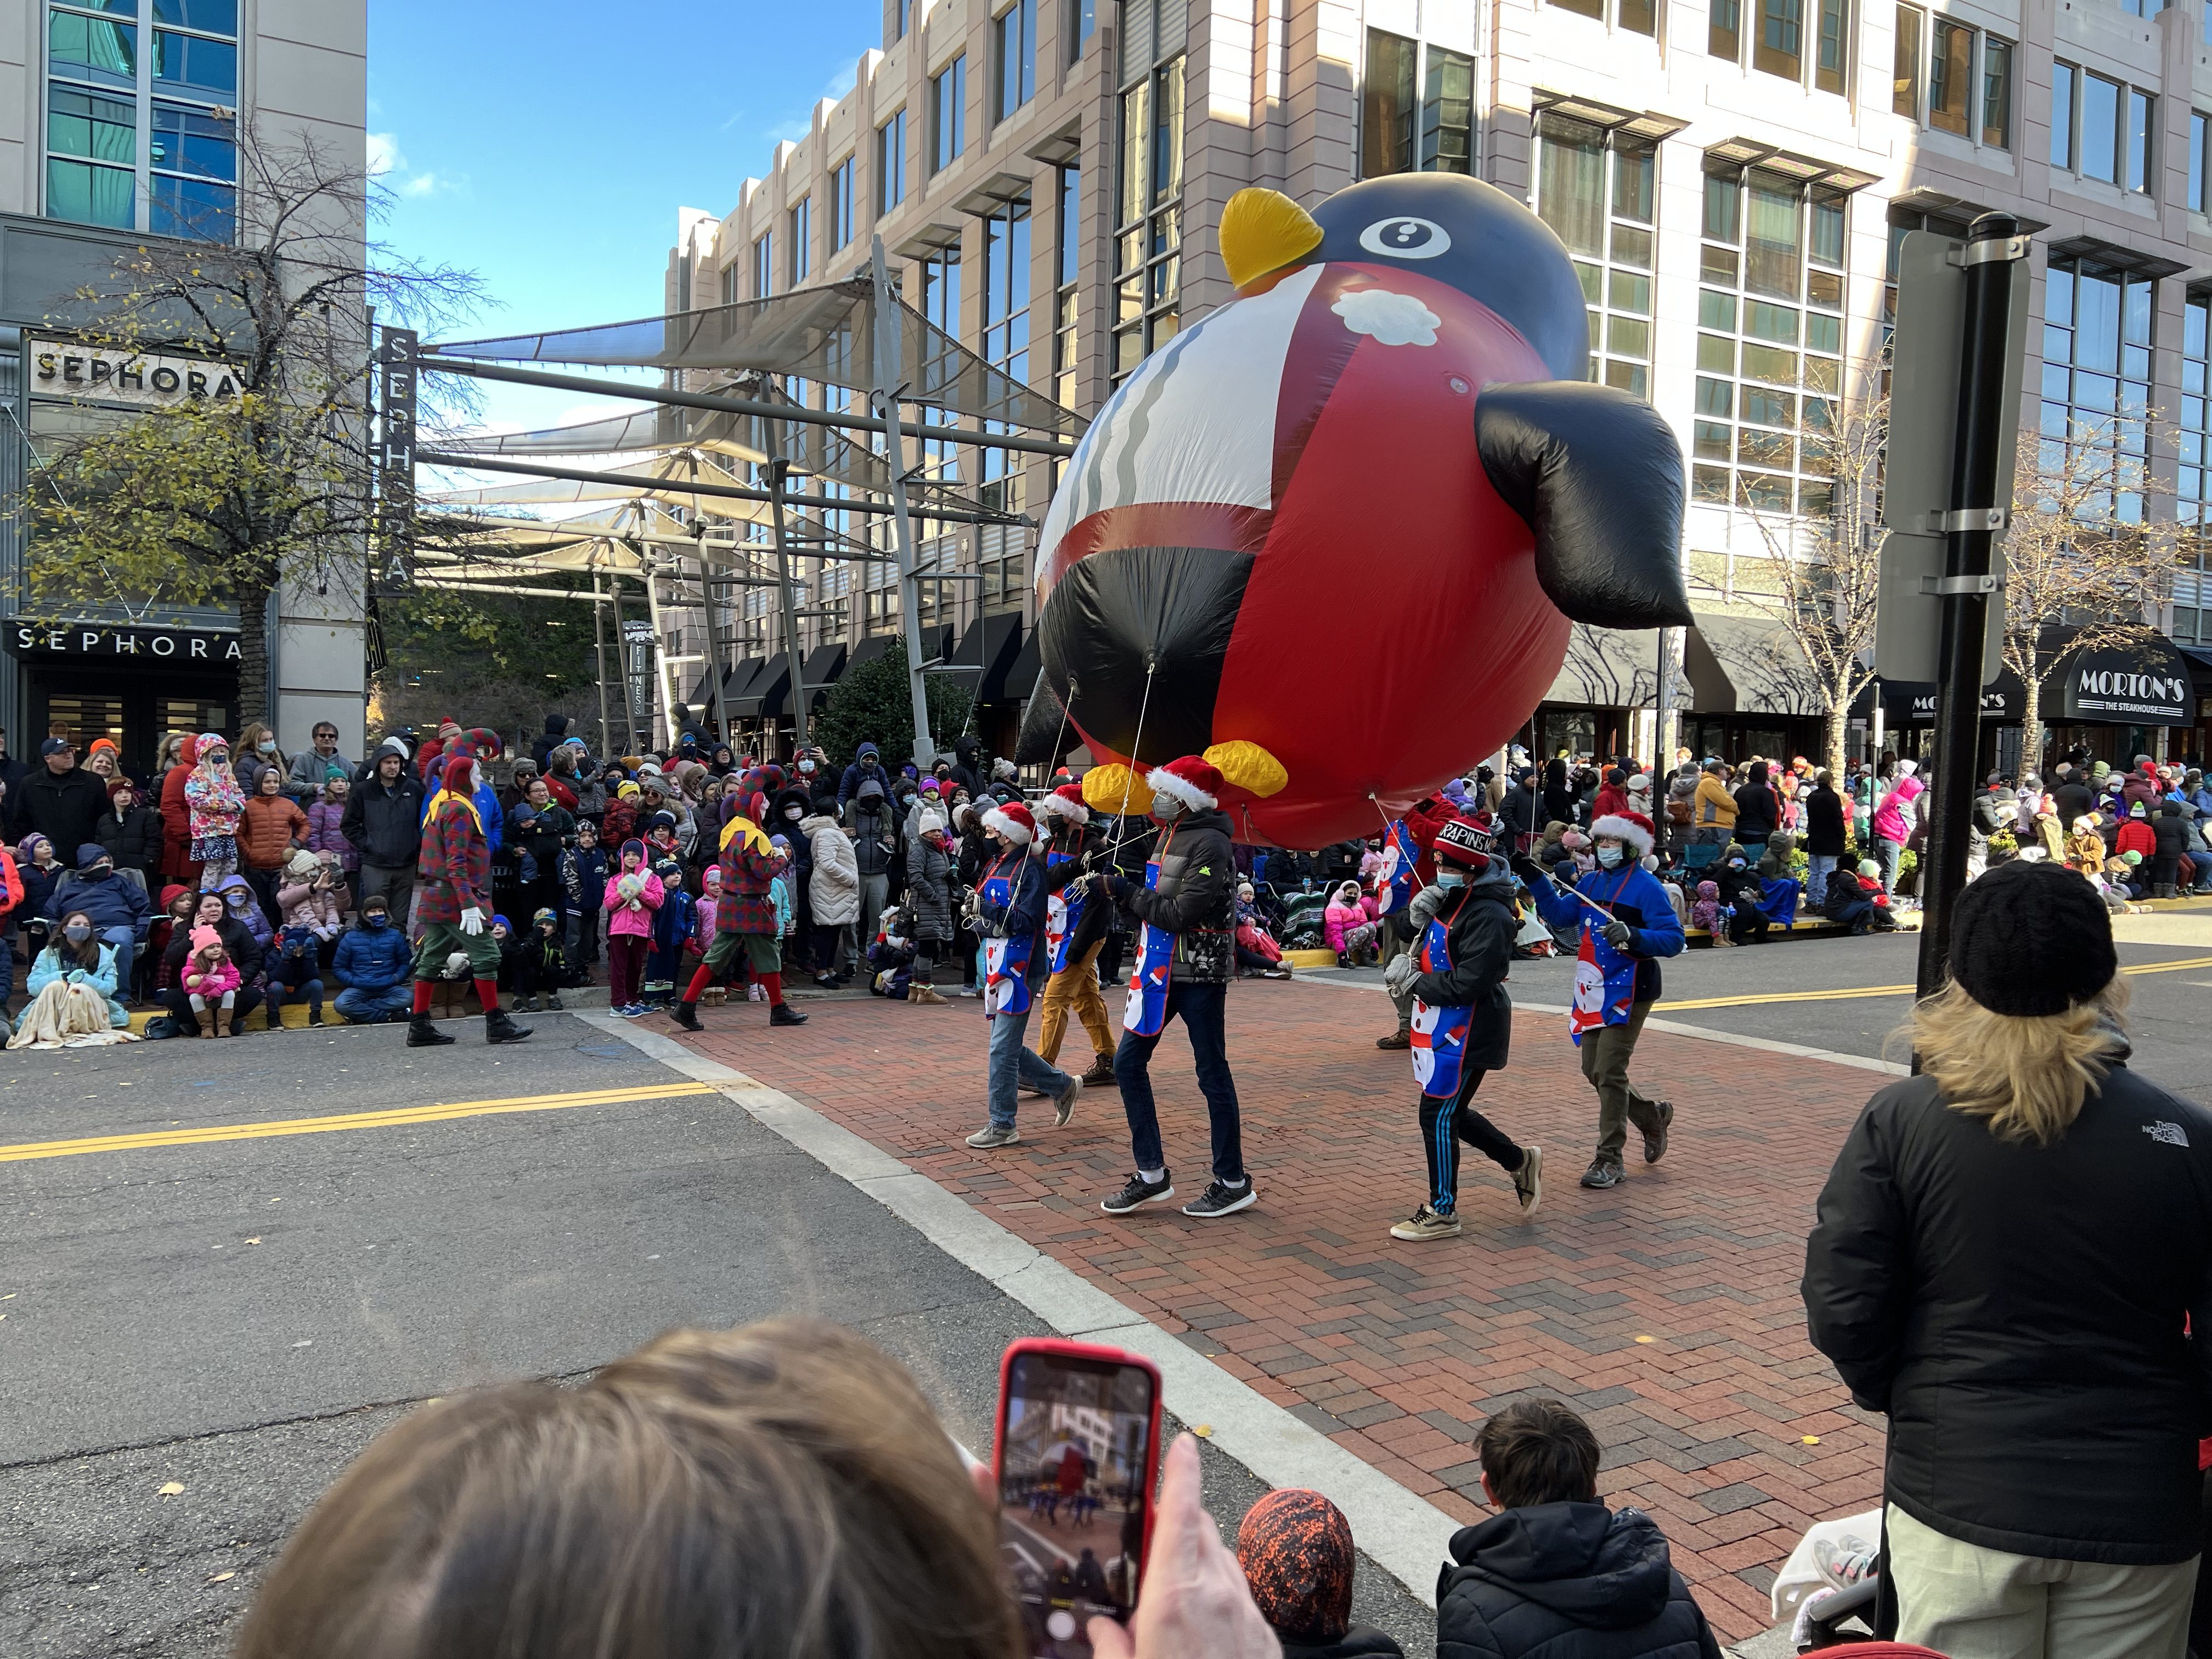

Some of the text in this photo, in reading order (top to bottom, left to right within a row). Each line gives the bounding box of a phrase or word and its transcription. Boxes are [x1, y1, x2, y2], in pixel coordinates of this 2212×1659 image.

[37, 352, 238, 400] SEPHORA
[385, 336, 410, 582] SEPHORA
[18, 628, 242, 659] SEPHORA
[2078, 669, 2185, 702] MORTON'S
[1912, 693, 2006, 710] MON'S
[2104, 701, 2159, 714] THE STEAKHOUSE
[1439, 823, 1485, 850] RAPINS
[2142, 1125, 2173, 1137] NORTH
[2155, 1120, 2174, 1131] THE
[2152, 1133, 2176, 1144] FACE
